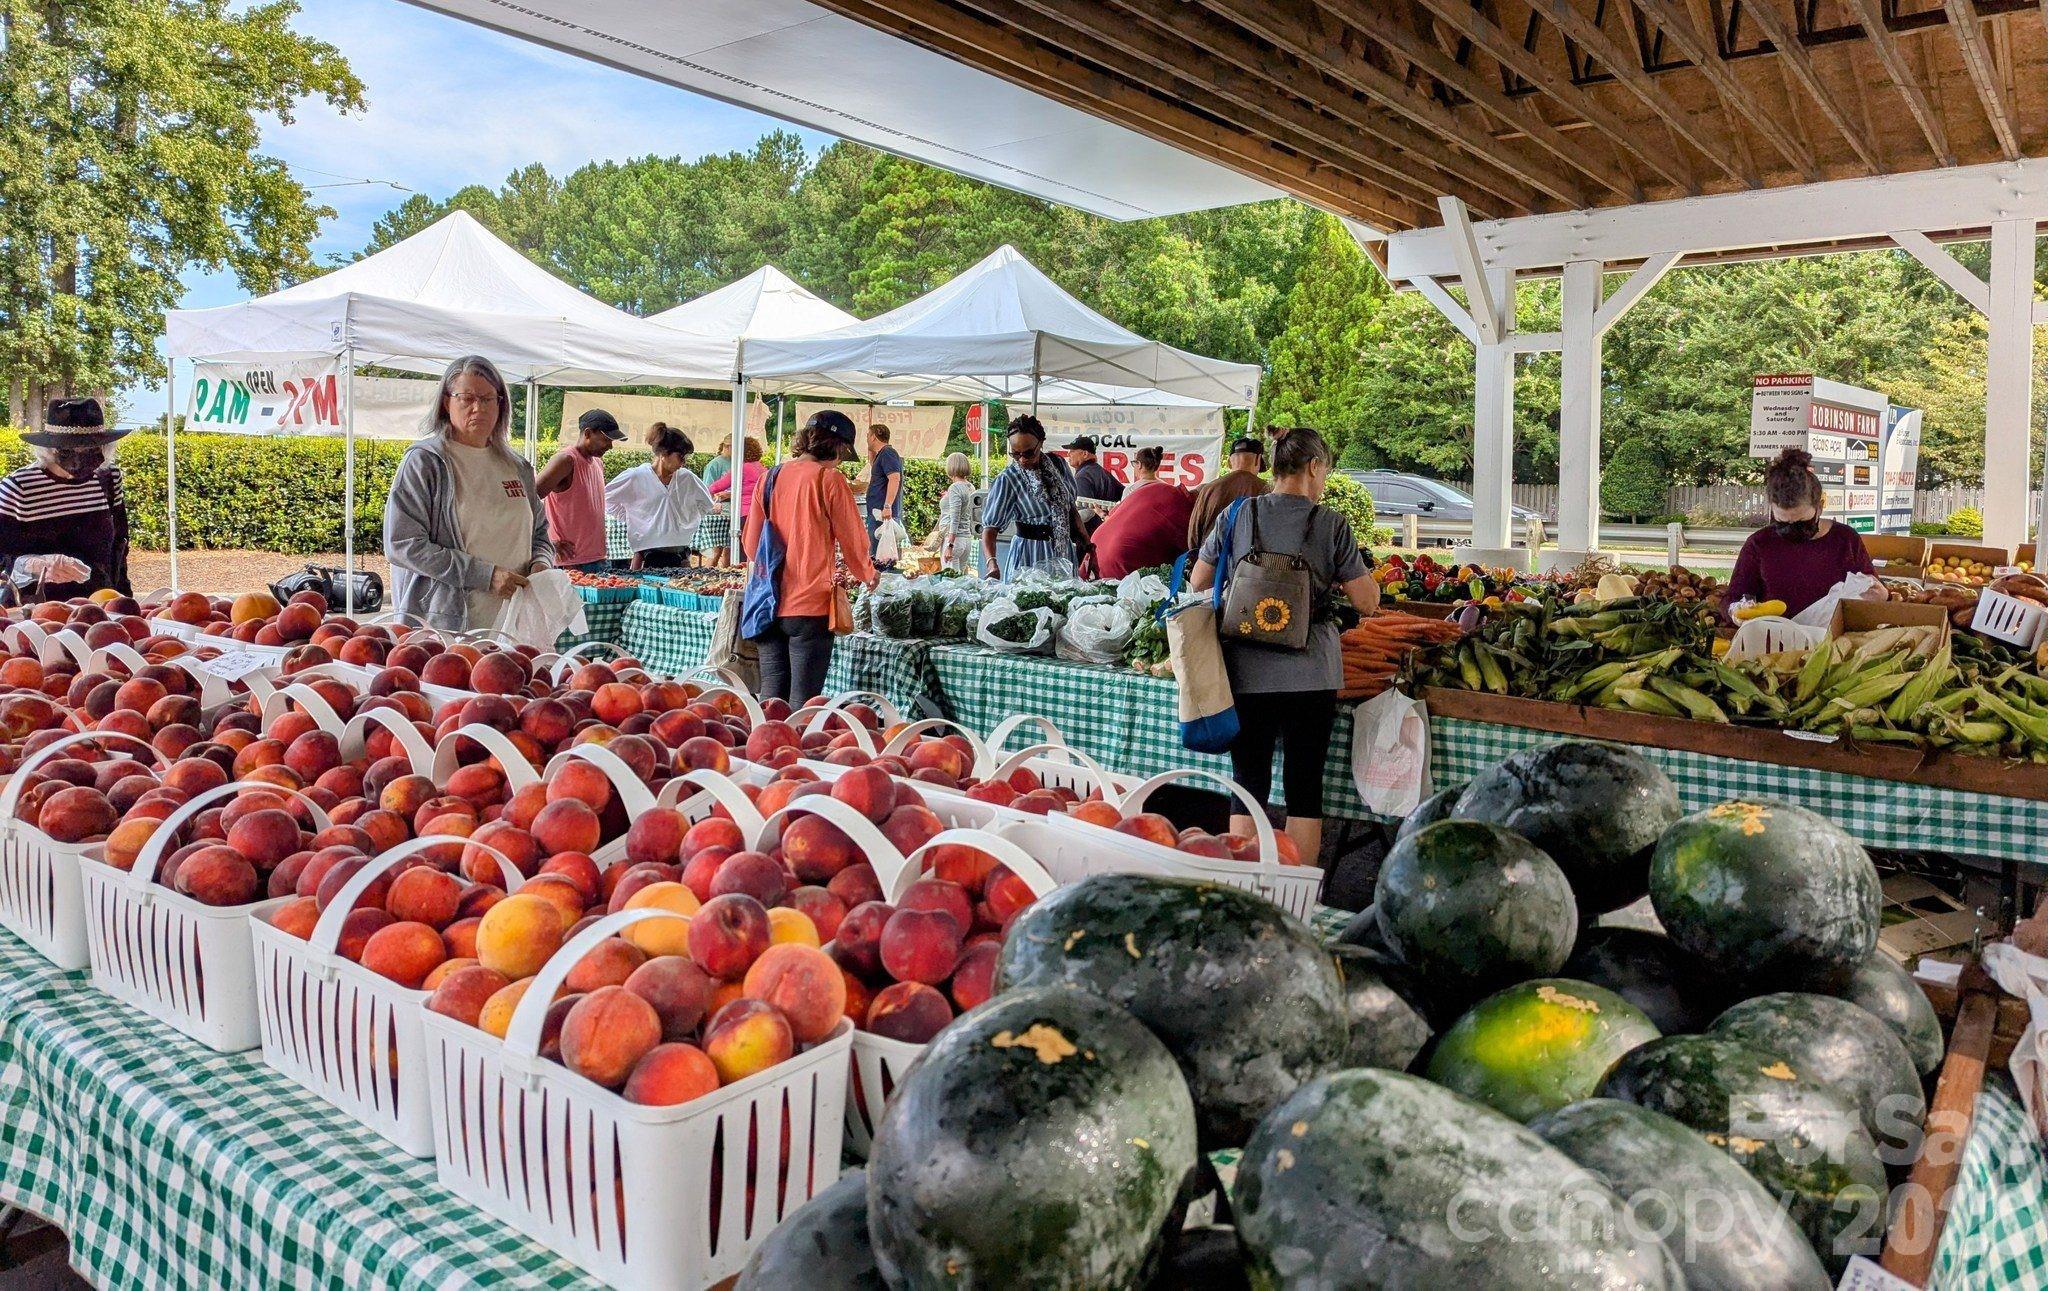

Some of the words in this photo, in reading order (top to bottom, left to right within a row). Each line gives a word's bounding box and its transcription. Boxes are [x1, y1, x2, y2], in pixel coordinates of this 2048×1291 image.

[245, 370, 278, 395] OPEN
[1755, 377, 1770, 386] NO
[1771, 376, 1812, 386] PARKING
[1763, 405, 1800, 413] Wednesday
[967, 417, 981, 432] STO
[1812, 405, 1855, 433] ROBINSON
[1857, 415, 1877, 436] FARM
[1080, 434, 1137, 448] OCAL
